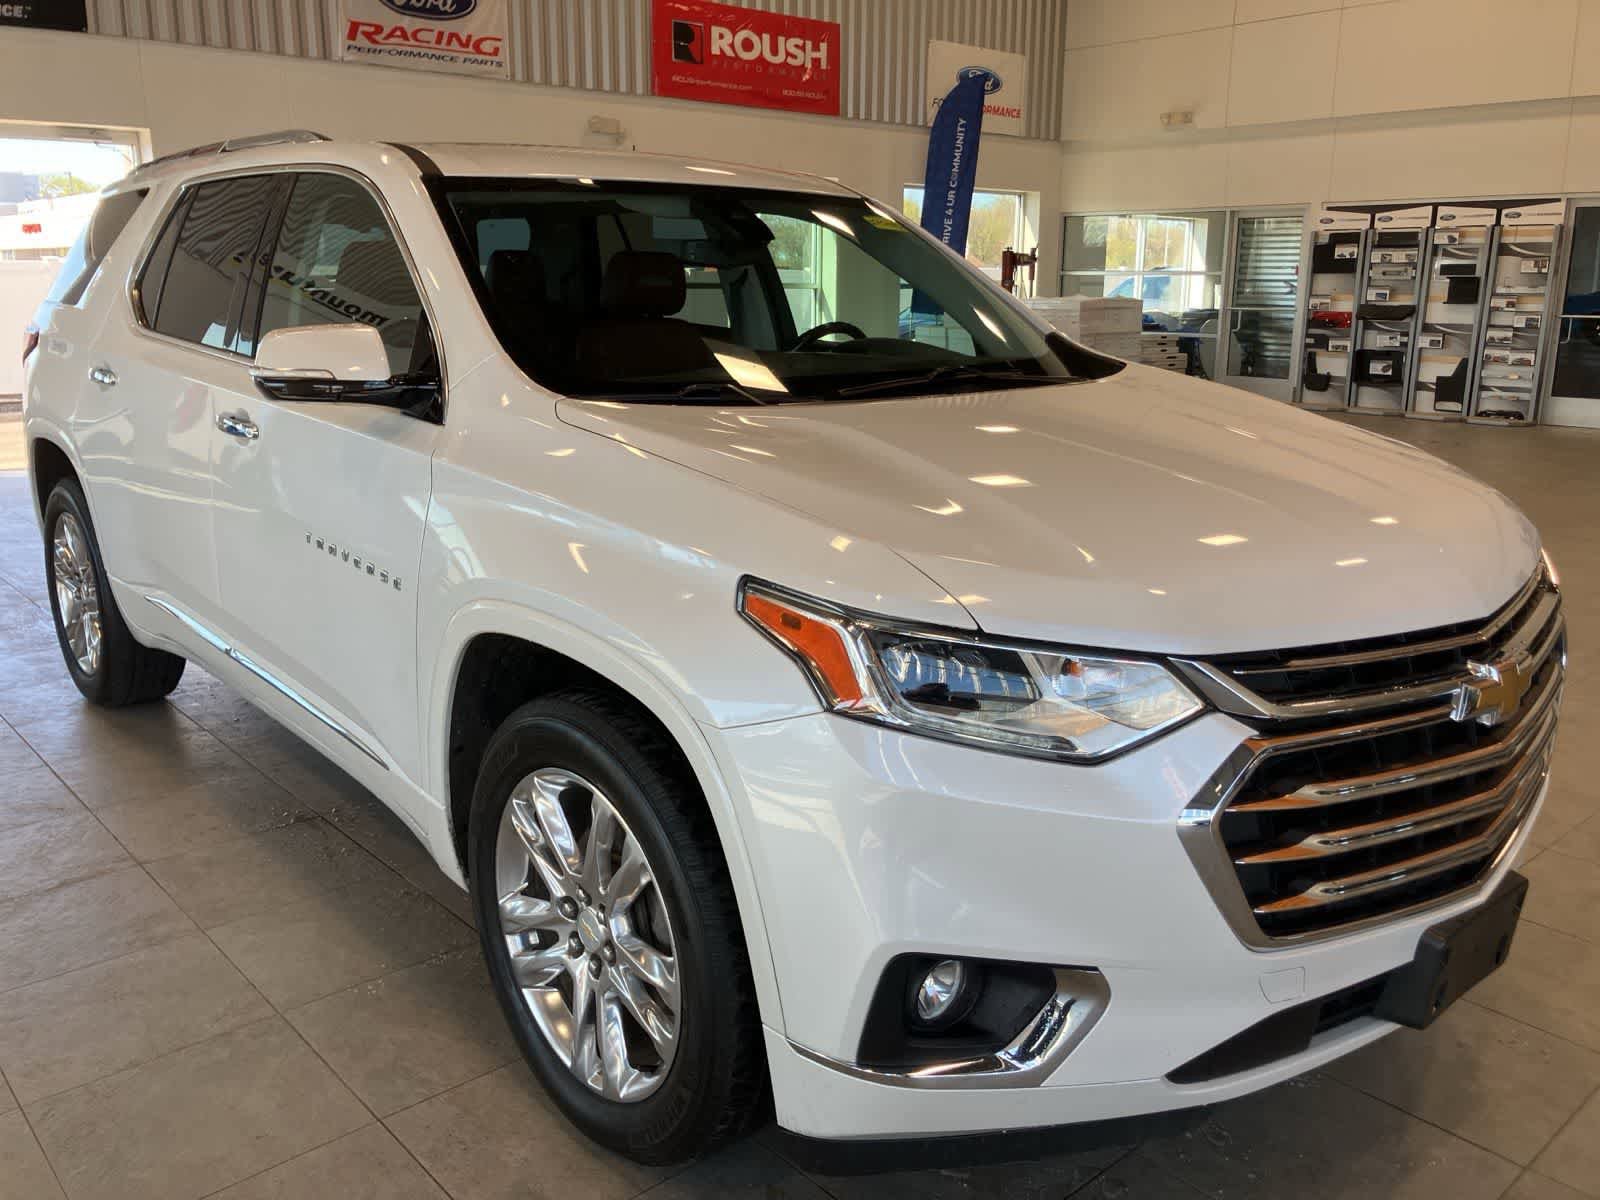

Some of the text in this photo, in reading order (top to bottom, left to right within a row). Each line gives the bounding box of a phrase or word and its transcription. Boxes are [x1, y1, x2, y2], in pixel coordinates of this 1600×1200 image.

[346, 18, 504, 57] RACING
[346, 44, 504, 68] PERFORMANCE PARTS
[710, 25, 828, 70] ROUSH
[982, 104, 1022, 118] ORMANCE
[942, 218, 953, 244] RIVE
[949, 117, 967, 188] COMMUNITY
[304, 531, 403, 591] TRAVERSE
